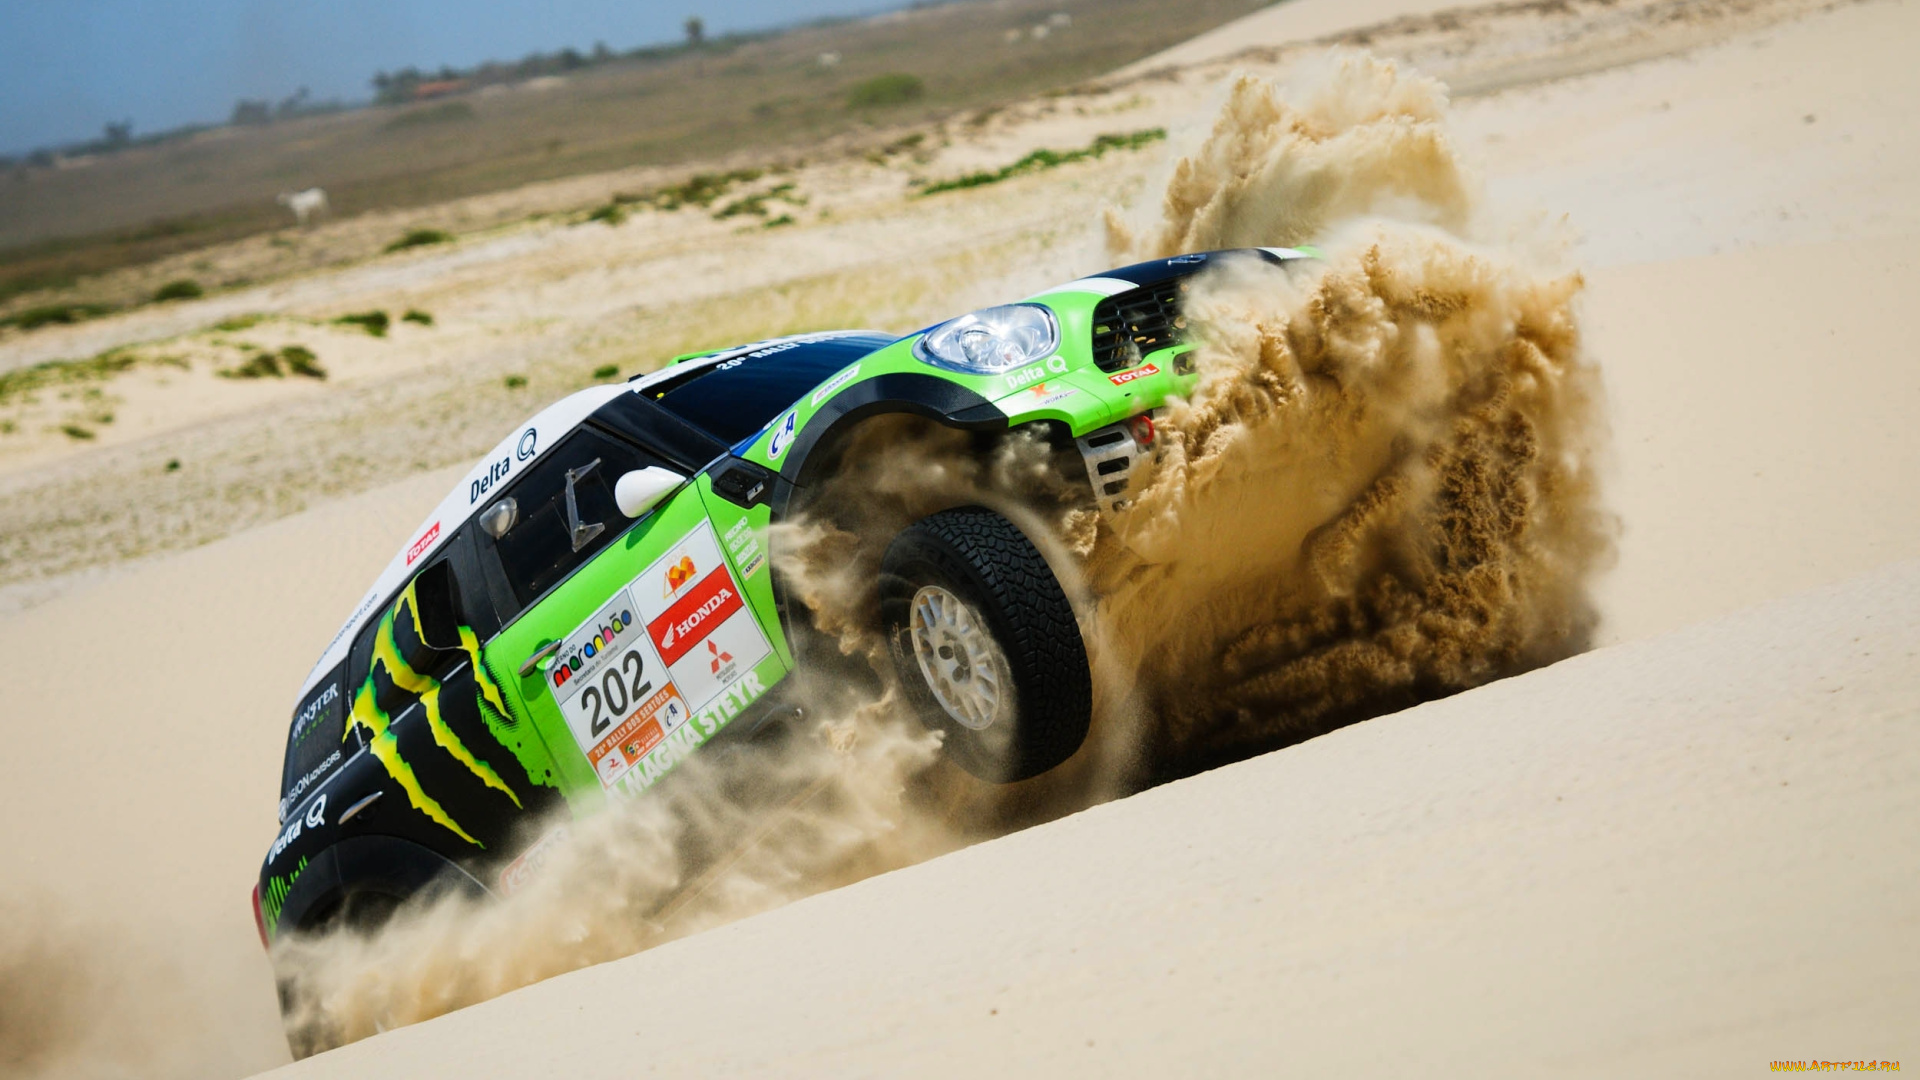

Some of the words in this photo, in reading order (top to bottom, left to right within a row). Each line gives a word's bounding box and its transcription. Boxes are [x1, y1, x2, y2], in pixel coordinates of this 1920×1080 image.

[1006, 365, 1046, 391] Delta
[1046, 355, 1069, 374] Q
[1110, 365, 1160, 384] TOTAL
[470, 457, 510, 505] Delta
[516, 428, 537, 462] Q
[408, 525, 440, 562] TOTAL
[675, 587, 732, 638] HONDA
[553, 609, 632, 688] maranhão
[581, 650, 652, 738] 202
[604, 726, 628, 747] RALLY
[625, 714, 642, 730] DOS
[622, 716, 704, 798] MAGNA
[697, 670, 766, 732] STEYR
